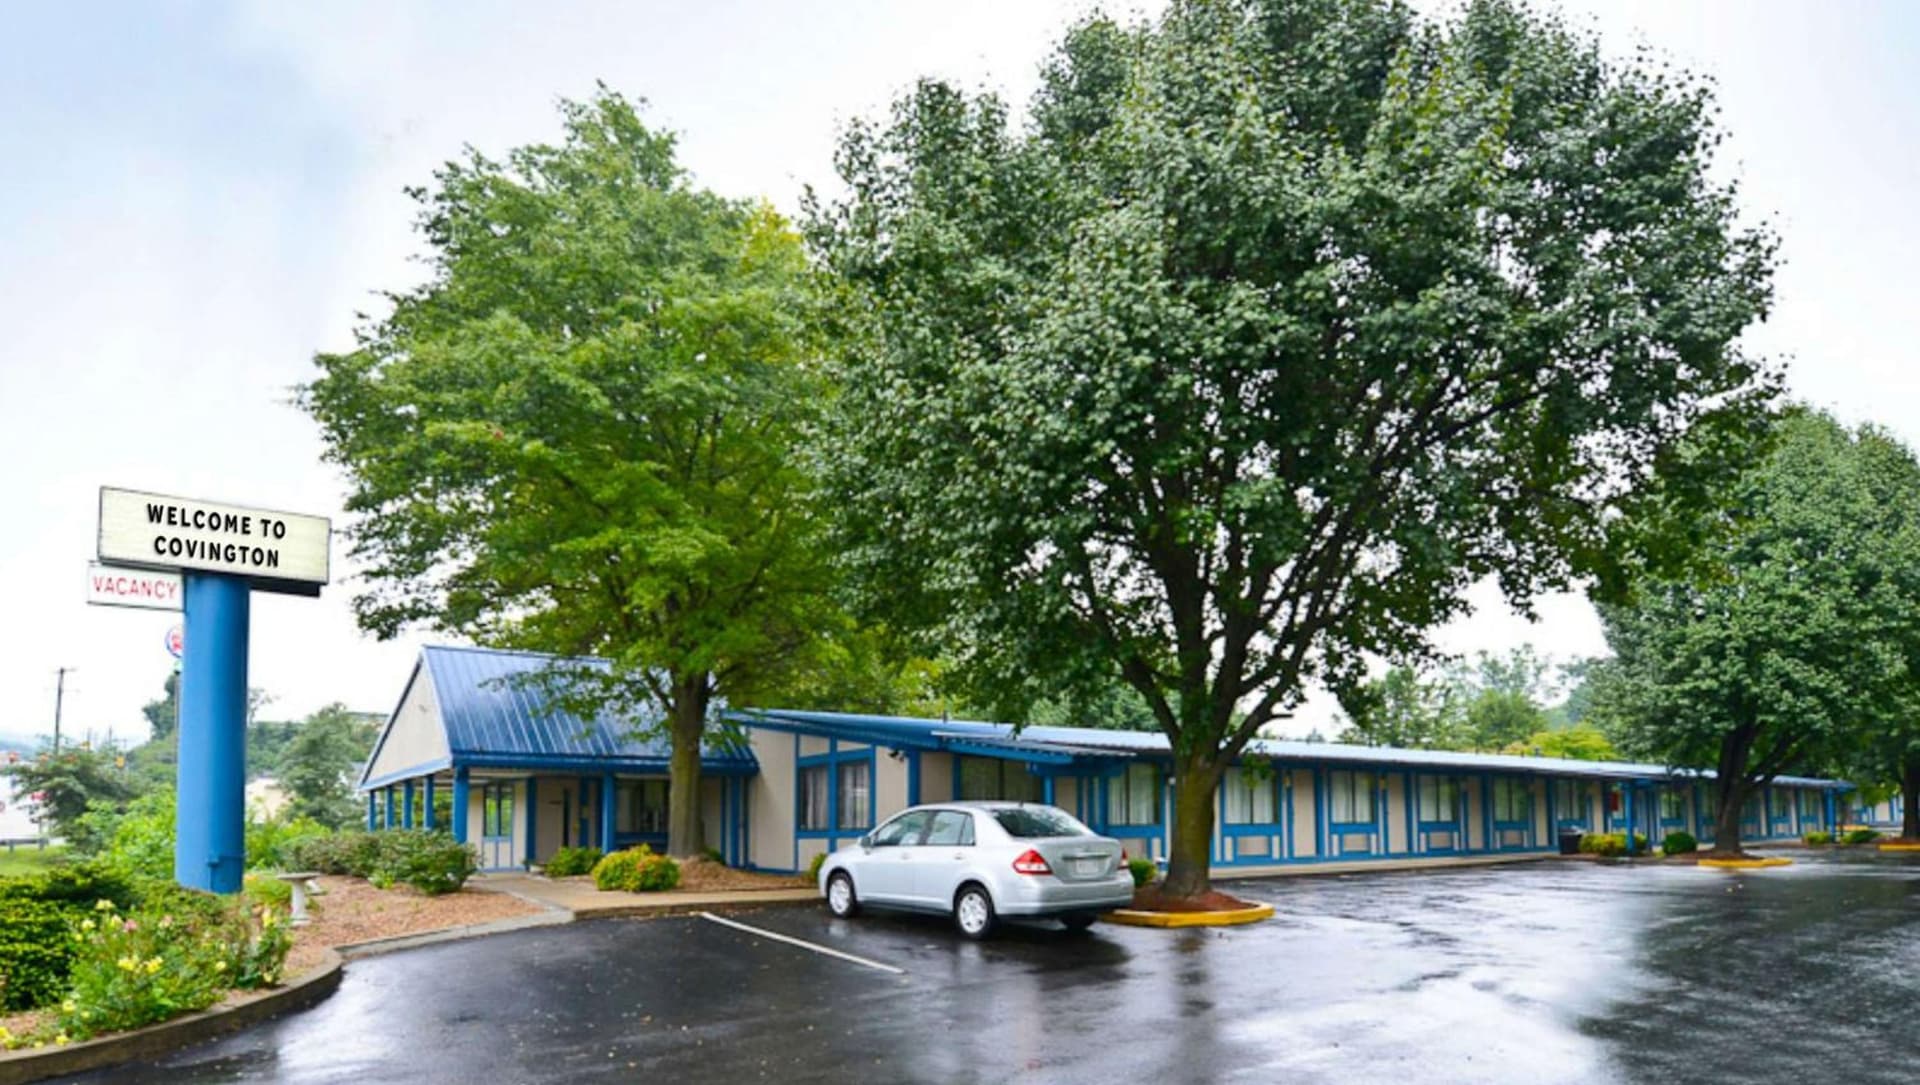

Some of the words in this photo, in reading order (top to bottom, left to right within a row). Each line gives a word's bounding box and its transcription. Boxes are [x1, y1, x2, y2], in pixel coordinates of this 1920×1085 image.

[147, 503, 251, 535] WELCOME
[260, 519, 286, 539] TO
[154, 536, 279, 567] COVINGTON
[93, 576, 178, 599] VACANCY
